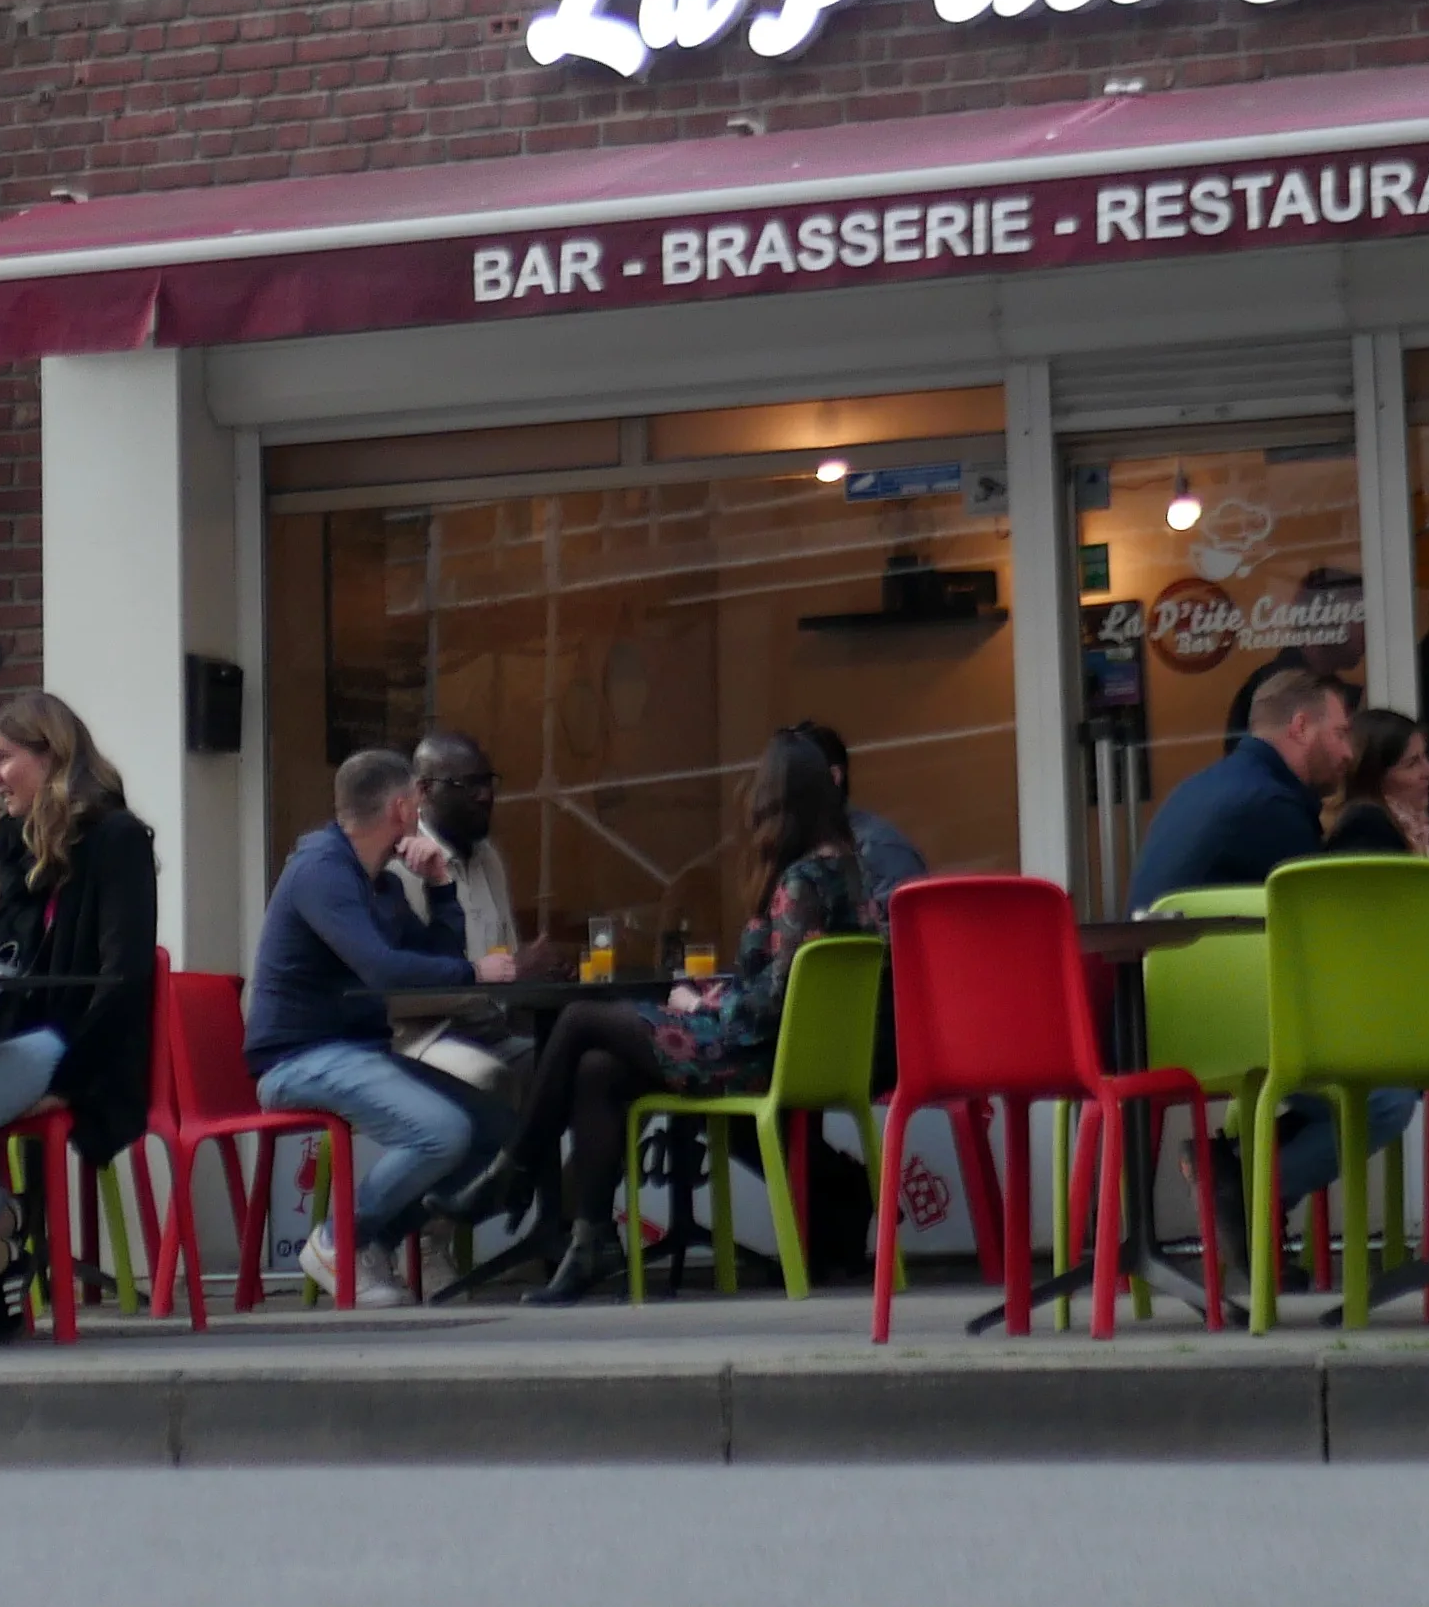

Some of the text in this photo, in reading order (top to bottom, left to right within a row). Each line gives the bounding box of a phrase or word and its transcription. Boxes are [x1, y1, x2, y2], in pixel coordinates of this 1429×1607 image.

[473, 241, 602, 303] BAR
[662, 198, 1033, 286] BRASSERIE
[1100, 595, 1367, 641] La P'tite Cantine
[1177, 632, 1217, 653] Bar
